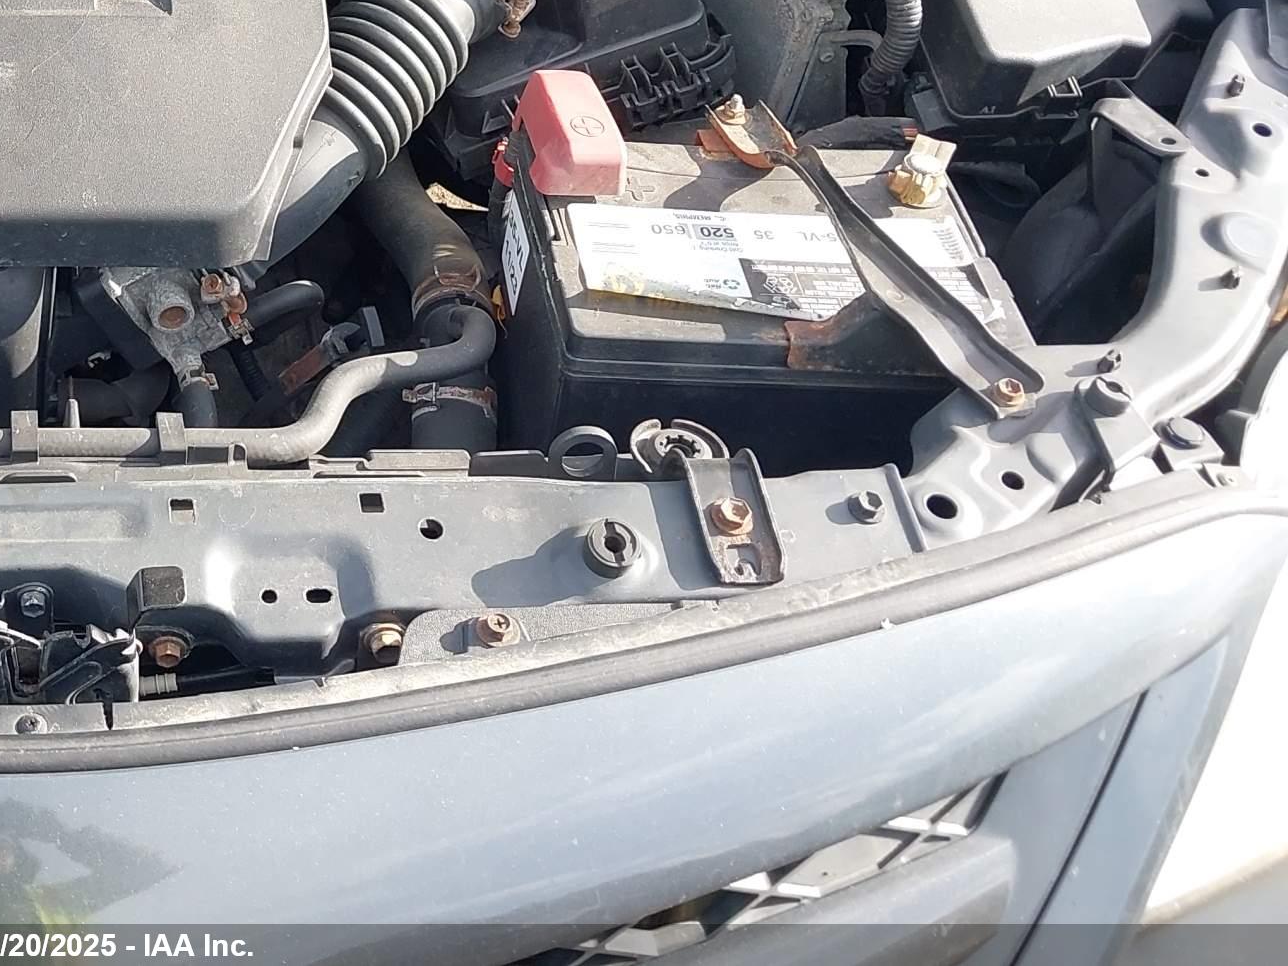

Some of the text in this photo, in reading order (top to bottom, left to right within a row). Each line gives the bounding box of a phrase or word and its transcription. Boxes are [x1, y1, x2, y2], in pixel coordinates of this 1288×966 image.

[651, 223, 837, 242] 5-VL 35 520 650
